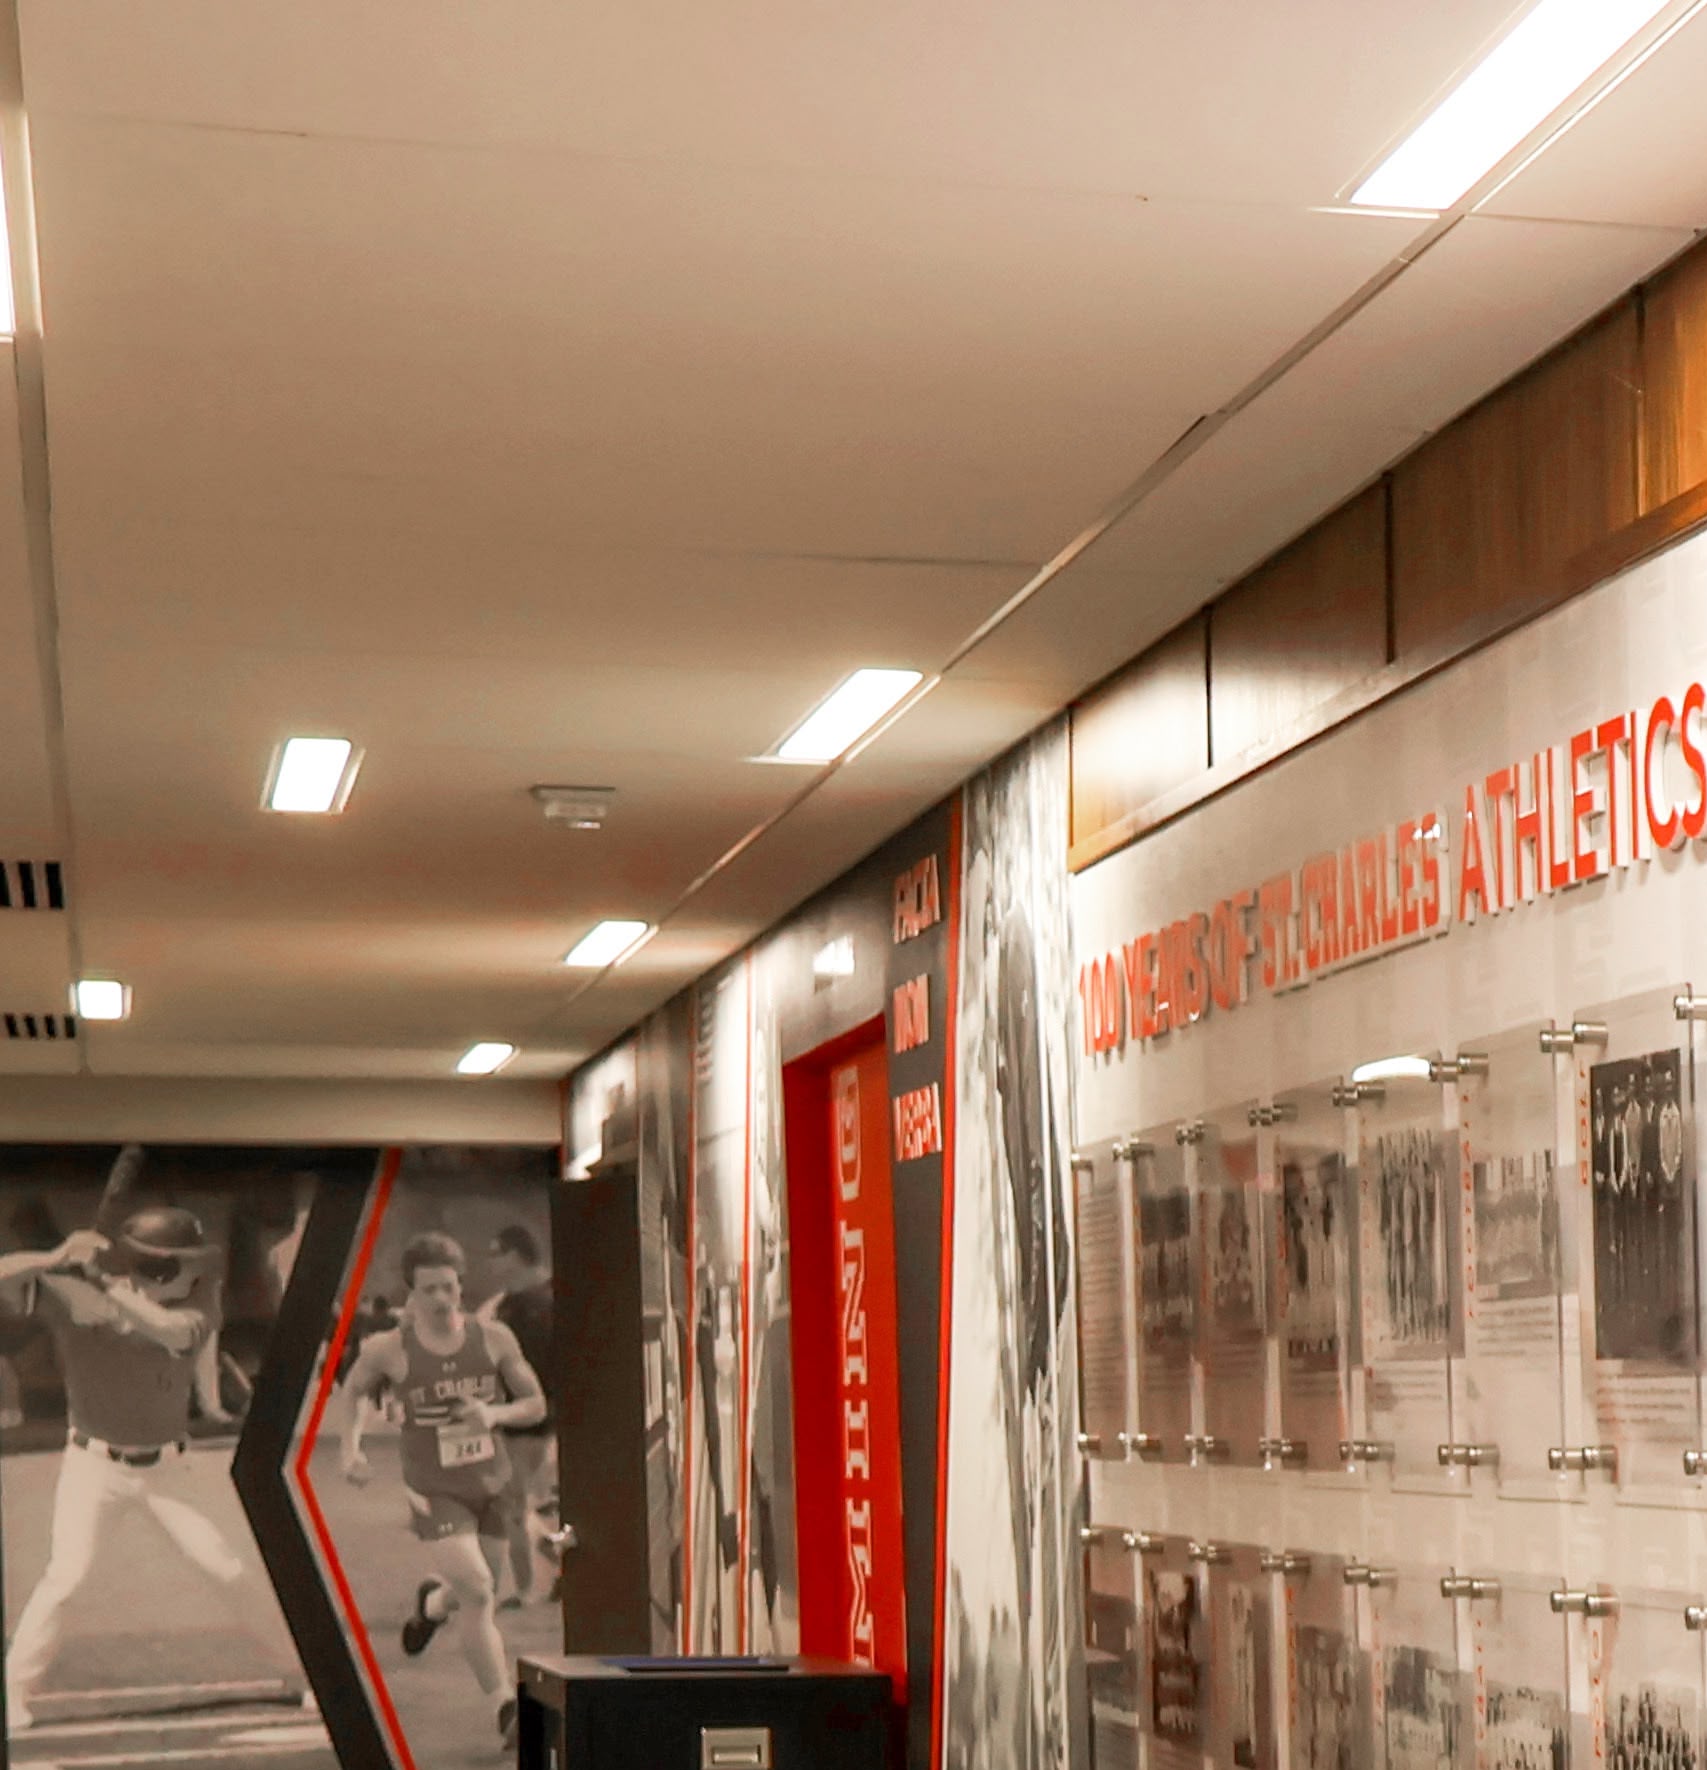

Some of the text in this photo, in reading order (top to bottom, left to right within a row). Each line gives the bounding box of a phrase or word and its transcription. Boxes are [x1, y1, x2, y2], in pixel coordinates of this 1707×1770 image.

[1079, 950, 1121, 1057] 100
[1122, 911, 1211, 1041] YEARS
[1211, 889, 1251, 1011] OF
[1301, 812, 1442, 970] CHARLES
